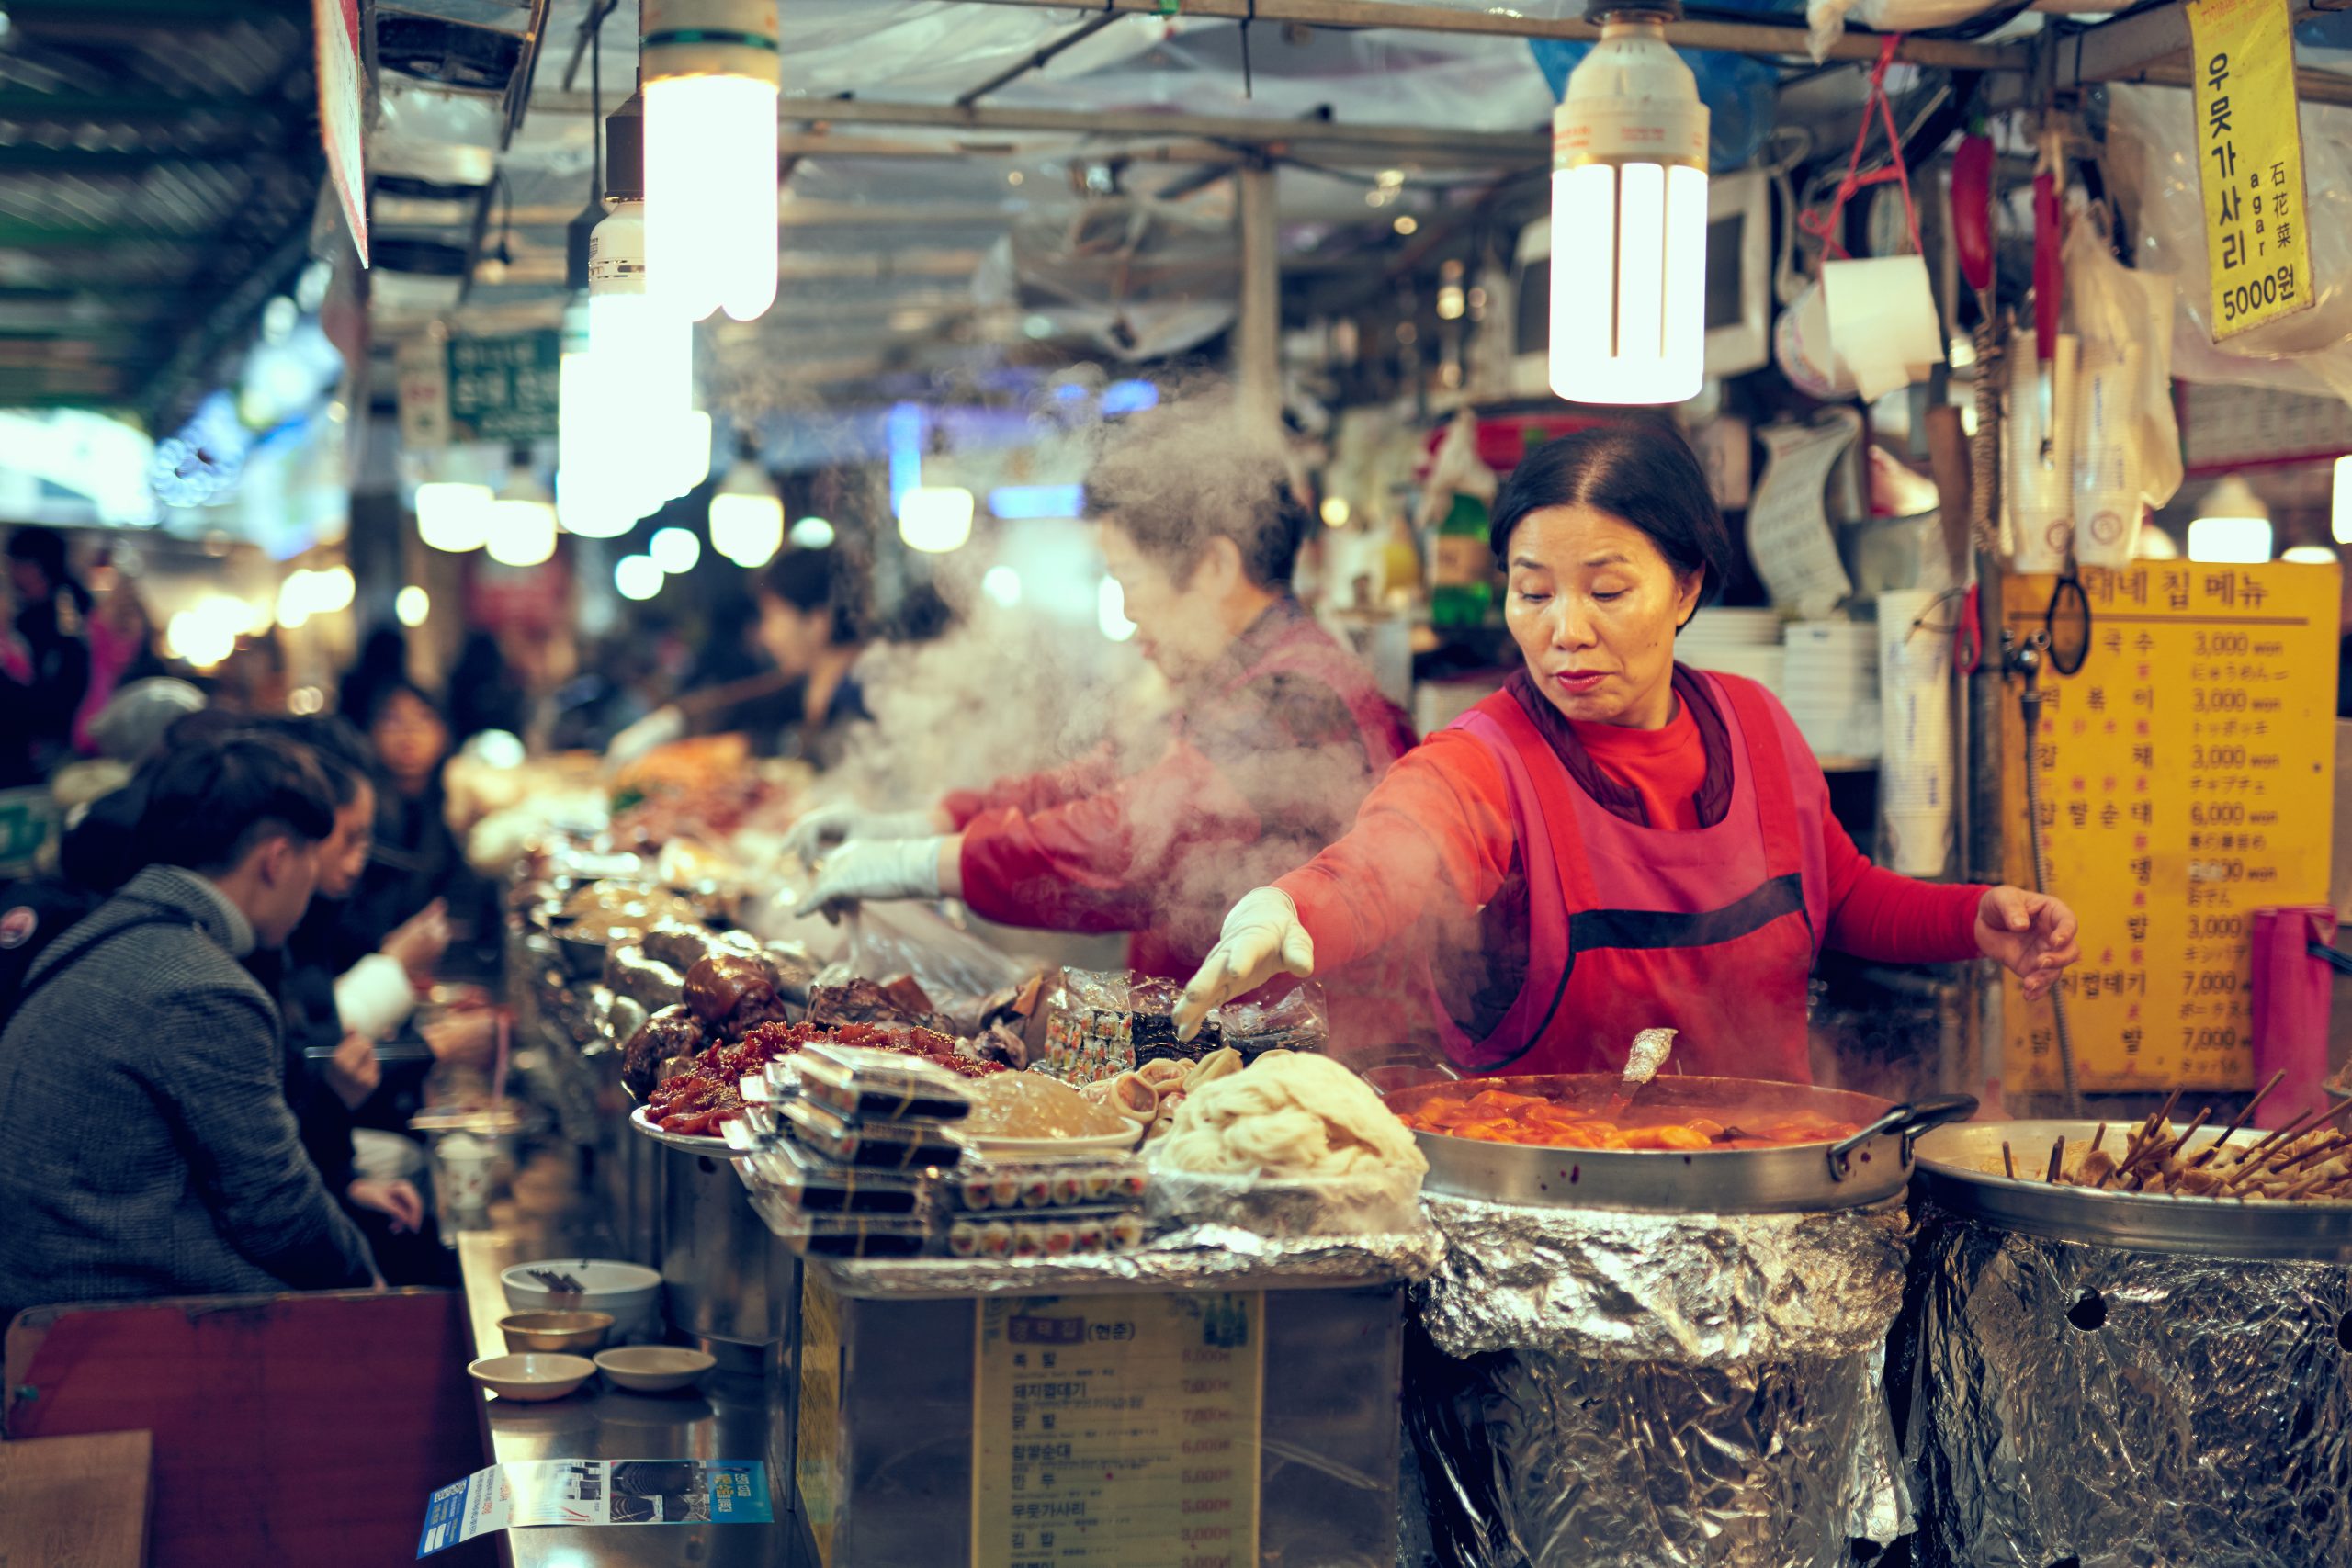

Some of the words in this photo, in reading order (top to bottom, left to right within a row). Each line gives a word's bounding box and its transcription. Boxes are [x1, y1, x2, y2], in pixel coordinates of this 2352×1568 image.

[2208, 53, 2245, 269] 우뭇가사리
[2250, 172, 2266, 257] agar
[2269, 162, 2291, 248] 石花菜
[2222, 264, 2294, 321] 5000원
[2193, 631, 2248, 658] 3,000
[2192, 687, 2247, 714] 3,000
[2190, 744, 2245, 772] 3,000
